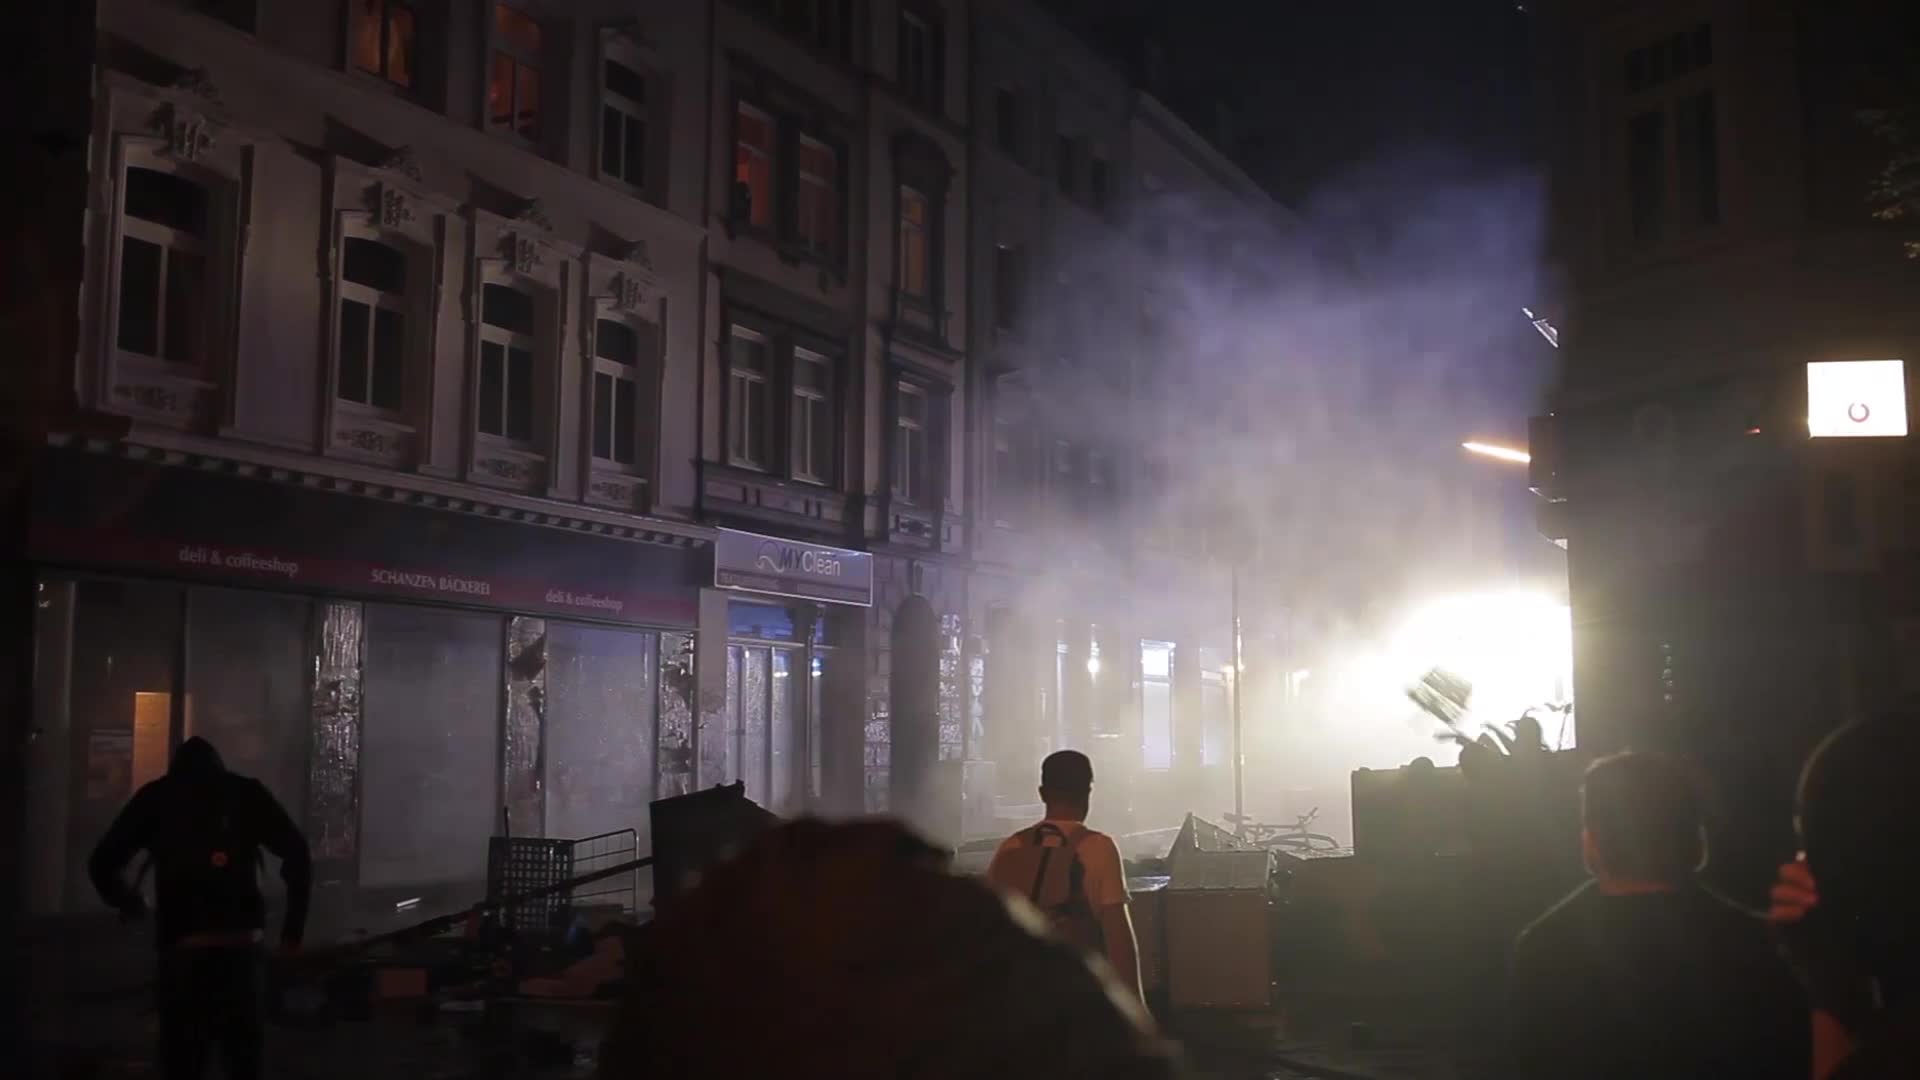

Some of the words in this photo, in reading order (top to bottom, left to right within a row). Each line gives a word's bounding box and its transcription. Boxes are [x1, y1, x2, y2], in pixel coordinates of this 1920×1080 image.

[179, 546, 208, 563] deli
[211, 551, 222, 565] &
[226, 553, 298, 576] coffeeshop
[371, 569, 436, 588] SCHANZEN
[440, 574, 490, 596] BÄCKEREI
[546, 589, 564, 603] deli
[565, 592, 573, 604] &
[575, 595, 622, 612] coffeeshop
